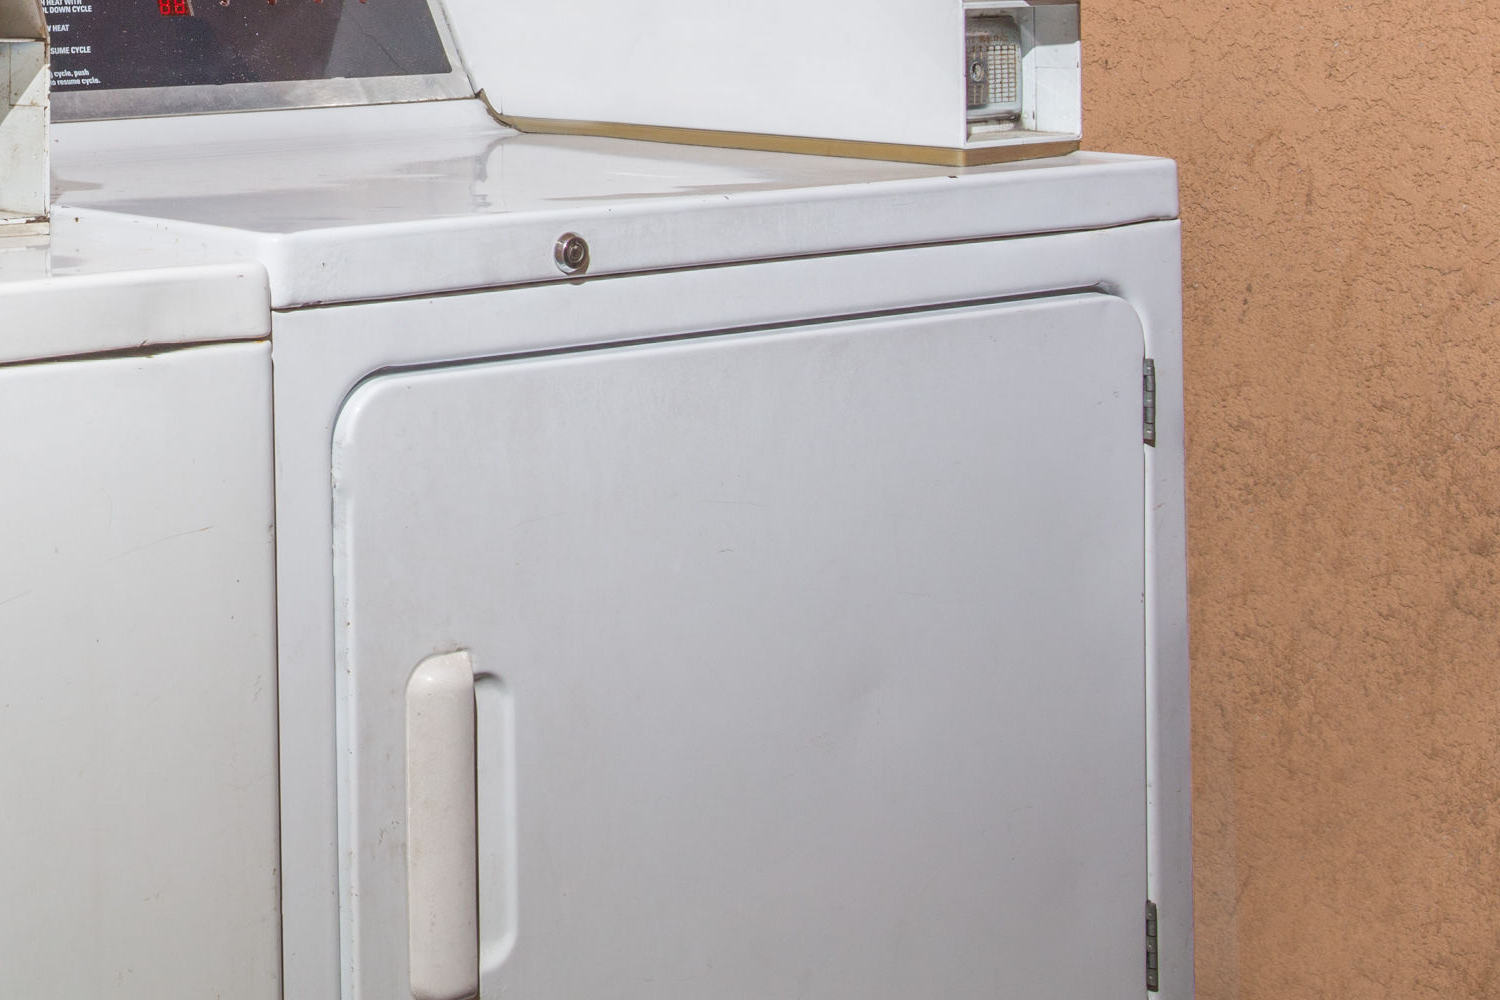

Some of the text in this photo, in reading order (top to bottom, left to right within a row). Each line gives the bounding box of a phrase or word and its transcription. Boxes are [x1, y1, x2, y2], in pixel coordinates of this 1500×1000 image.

[50, 6, 71, 14] DOWN
[72, 5, 92, 13] CYCLE
[53, 24, 70, 32] HEAT
[71, 46, 92, 54] CYCLE
[74, 68, 90, 77] push
